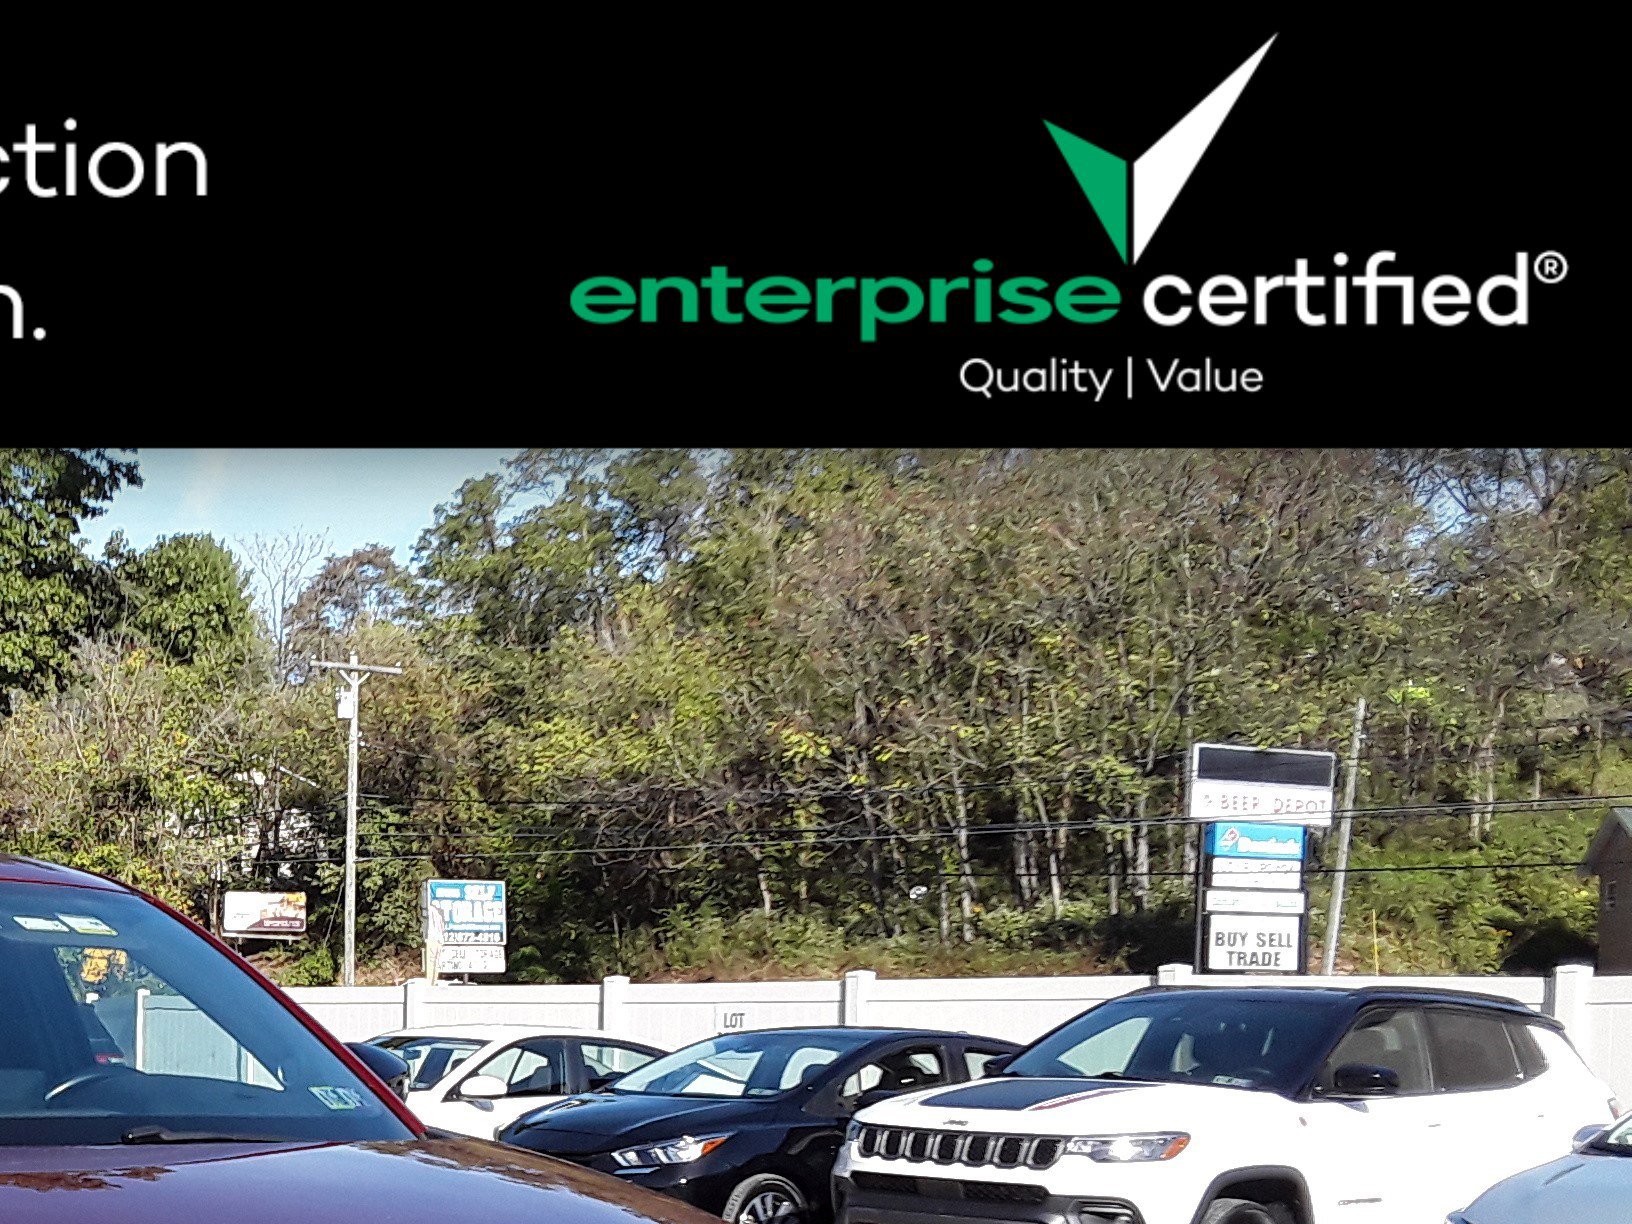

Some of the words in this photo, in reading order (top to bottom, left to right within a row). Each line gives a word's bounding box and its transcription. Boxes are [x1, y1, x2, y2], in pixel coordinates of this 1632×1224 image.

[1215, 931, 1248, 947] BUY
[1256, 931, 1293, 948] SELL
[1226, 950, 1282, 967] TRADE
[723, 1012, 746, 1029] LOT
